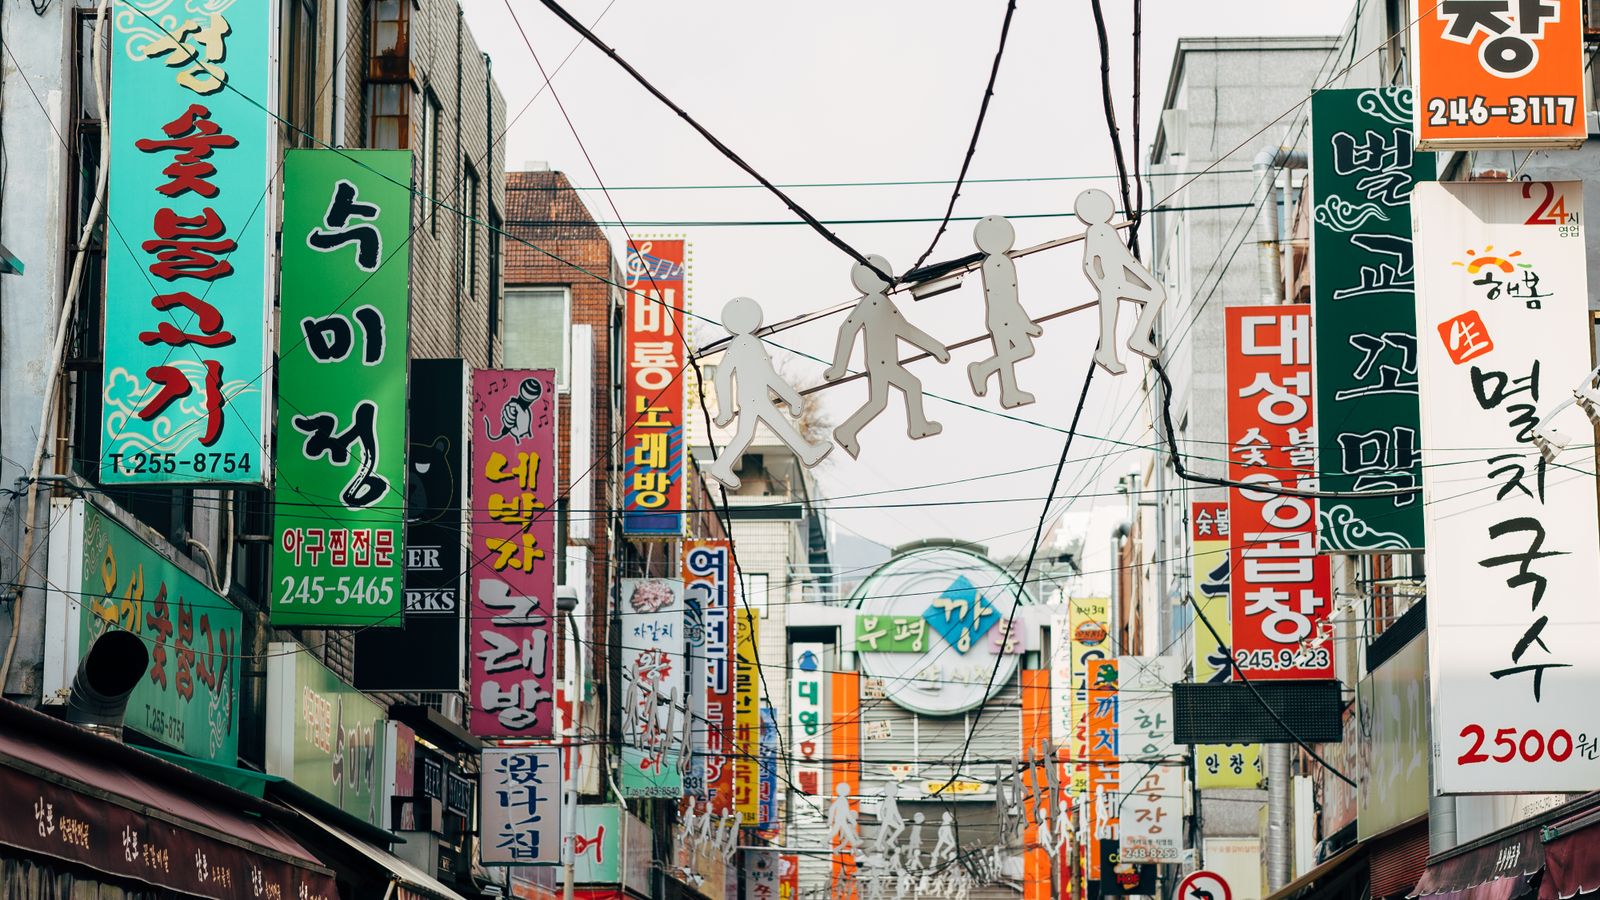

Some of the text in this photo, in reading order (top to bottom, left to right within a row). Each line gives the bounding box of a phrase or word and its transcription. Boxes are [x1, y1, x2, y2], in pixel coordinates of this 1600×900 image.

[1428, 96, 1577, 127] 246-3117
[1558, 226, 1580, 238] 영업
[135, 104, 240, 446] 숯불고기
[1473, 271, 1554, 309] 해봄
[292, 178, 387, 510] 수미정
[1239, 314, 1312, 424] 대성
[109, 453, 251, 474] T.255-8754
[634, 395, 673, 508] 노래방
[283, 528, 394, 567] 아구찜전문
[1470, 359, 1573, 704] 멸치국수
[280, 577, 394, 605] 245-5465
[477, 452, 549, 729] 네박자 노래방
[633, 621, 674, 641] 자갈치
[857, 616, 926, 651] 부평
[683, 776, 703, 788] 931
